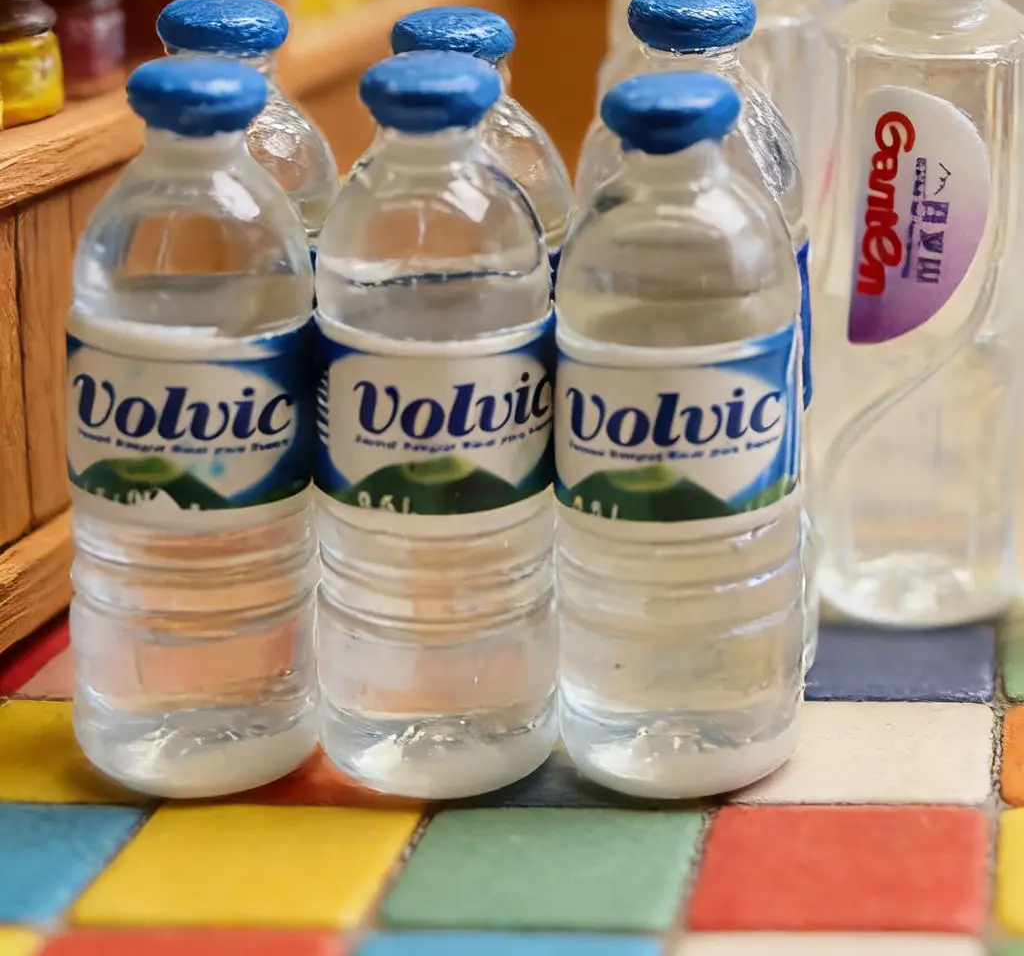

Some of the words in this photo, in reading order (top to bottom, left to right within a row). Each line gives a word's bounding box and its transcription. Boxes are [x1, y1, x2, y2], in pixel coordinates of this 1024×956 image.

[73, 372, 295, 441] Volvic
[353, 371, 551, 440] Volvic
[566, 386, 782, 447] Volvic
